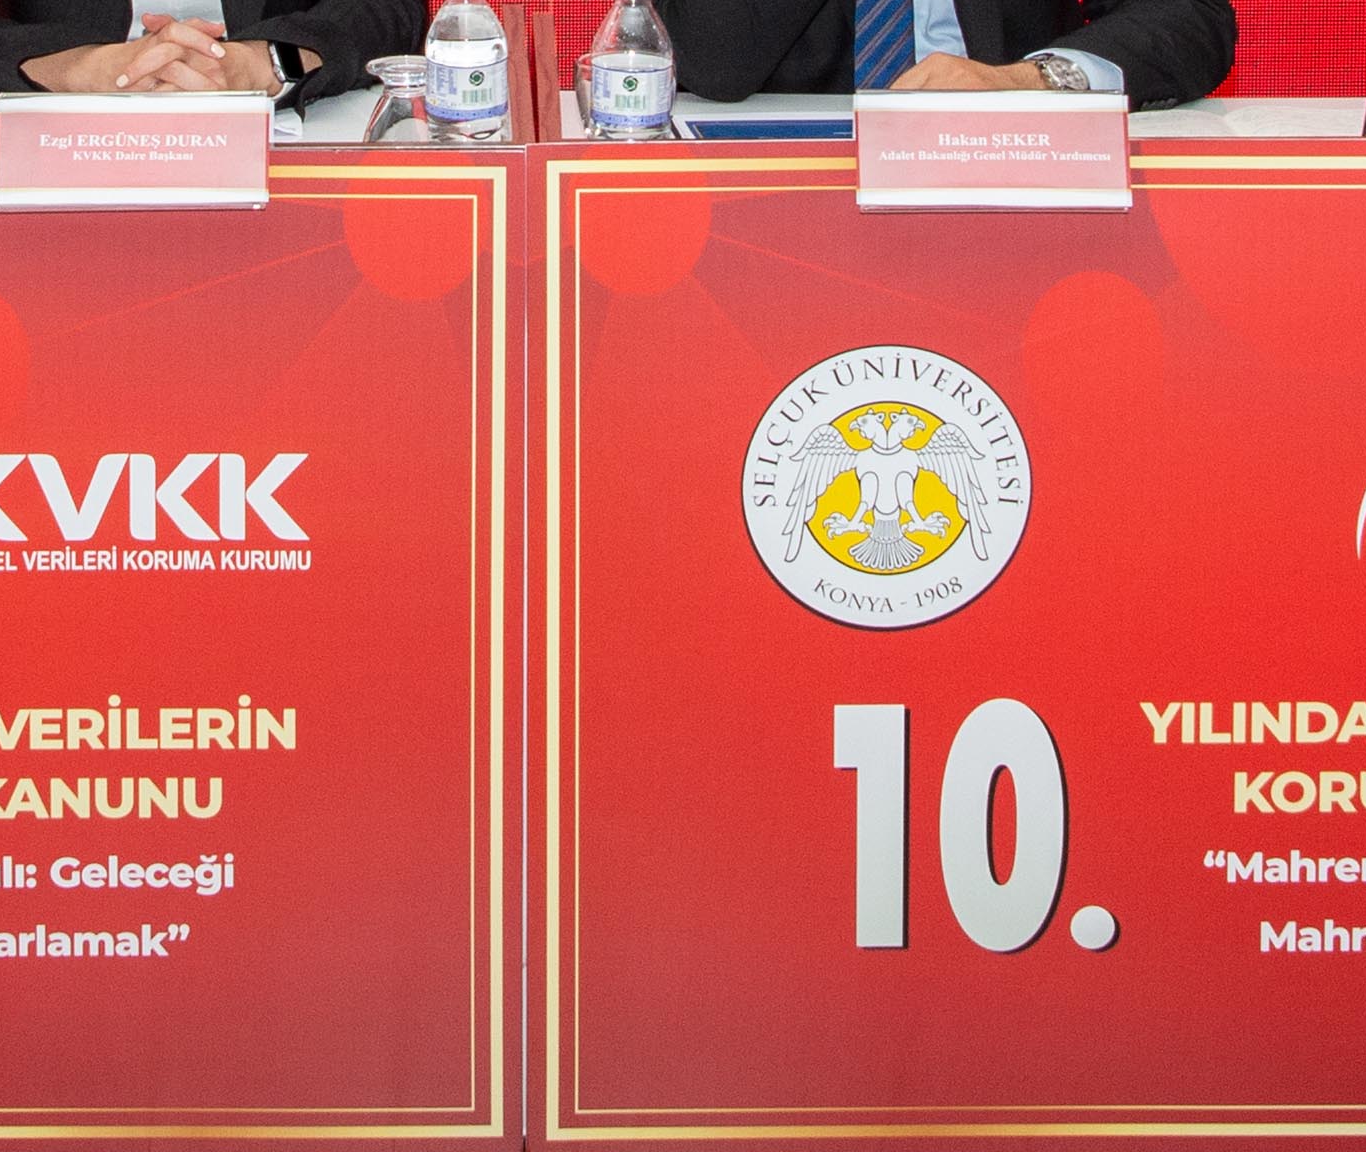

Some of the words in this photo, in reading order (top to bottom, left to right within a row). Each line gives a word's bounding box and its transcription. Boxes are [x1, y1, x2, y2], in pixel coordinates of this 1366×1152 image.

[40, 135, 72, 149] Ezgi
[78, 132, 161, 149] ERGÜNEŞ
[166, 135, 227, 147] DURAN
[939, 134, 987, 146] Hakan
[992, 134, 1050, 148] ŞEKER
[73, 151, 111, 160] KVKK
[115, 151, 146, 160] Daire
[879, 151, 915, 160] Adalet
[973, 151, 1006, 160] Genel
[753, 379, 830, 508] SELÇUK
[832, 352, 1024, 505] ÜNİVERSİTESİ
[23, 546, 117, 570] VERİLERİ
[123, 550, 215, 570] KORUMA
[221, 550, 311, 570] KURUMU
[813, 578, 894, 613] KONYA
[914, 576, 964, 608] 1908
[834, 698, 1115, 951] 10.
[50, 853, 234, 895] Geleceği
